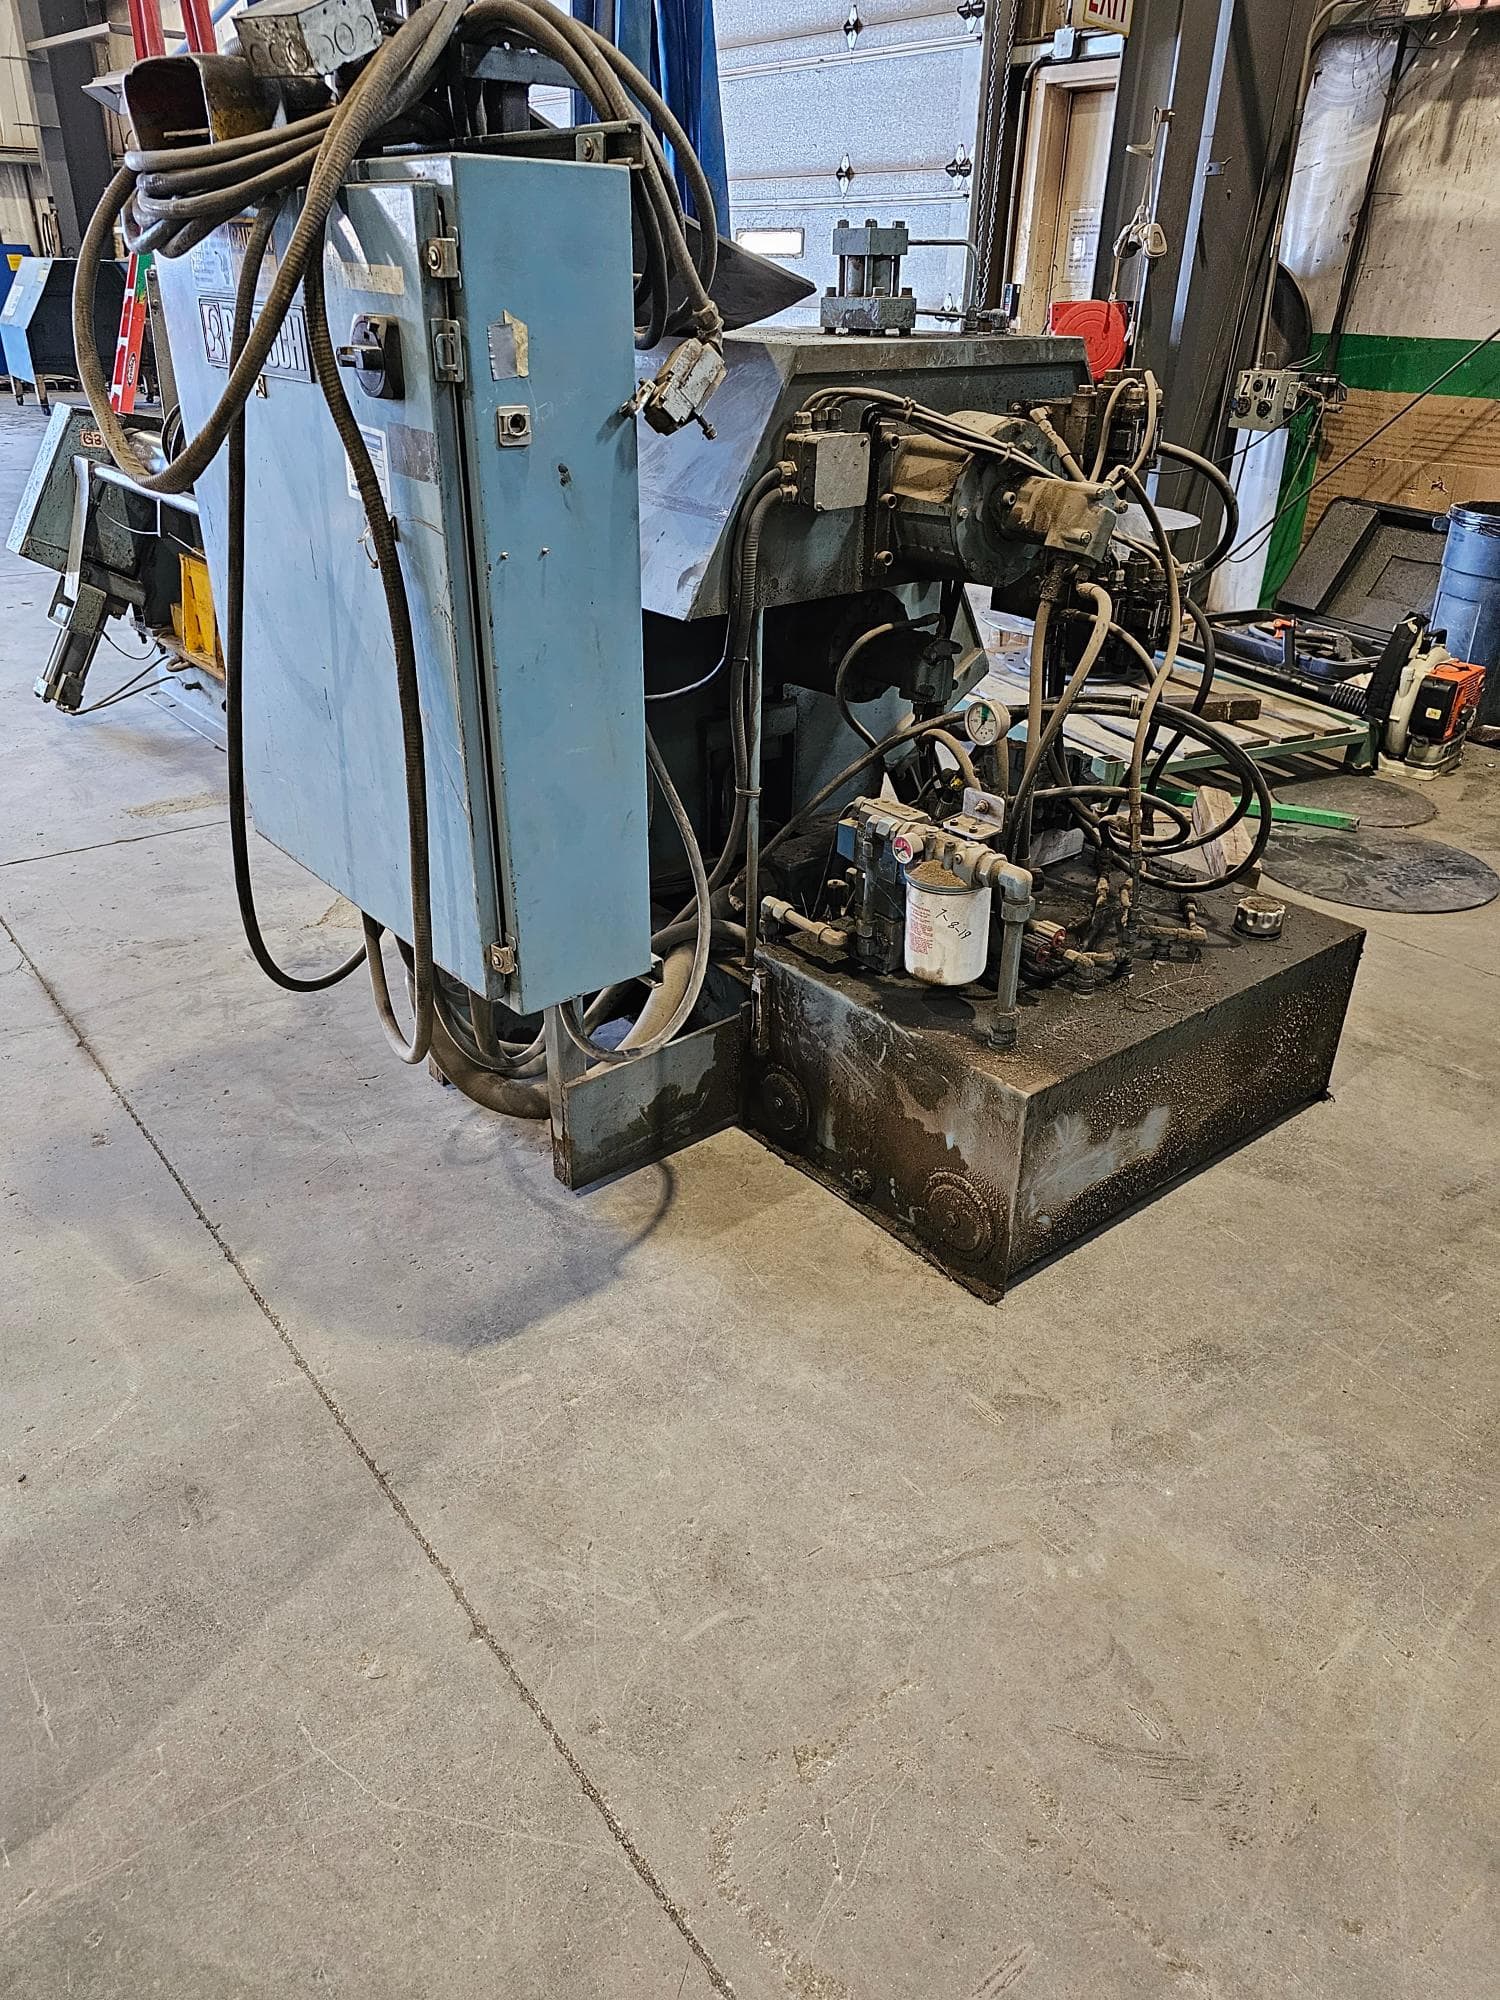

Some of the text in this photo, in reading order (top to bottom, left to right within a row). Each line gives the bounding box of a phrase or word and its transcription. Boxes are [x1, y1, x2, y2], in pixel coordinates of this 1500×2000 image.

[1240, 374, 1278, 400] Z M
[935, 907, 972, 940] 7-8-19
